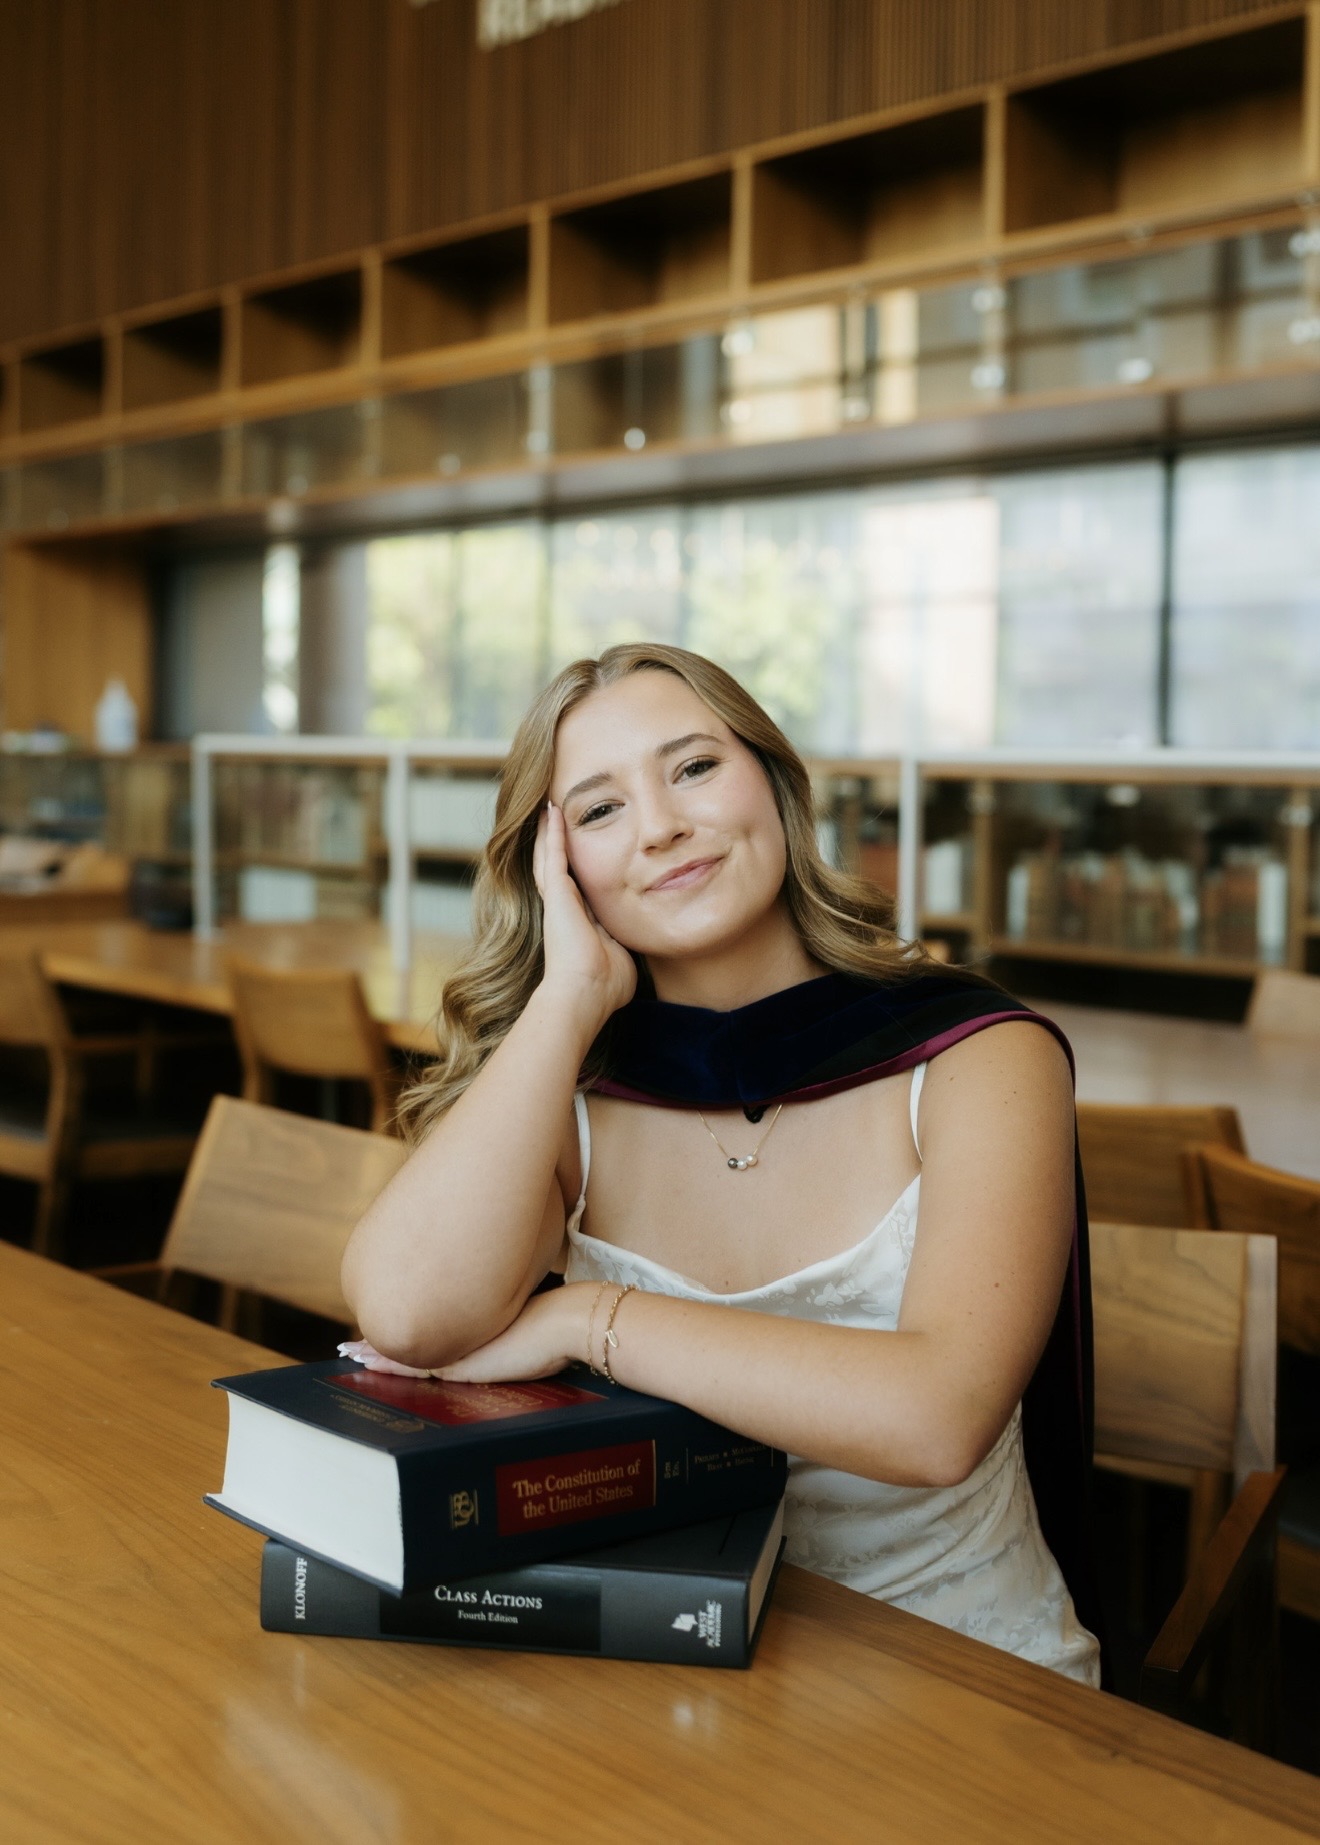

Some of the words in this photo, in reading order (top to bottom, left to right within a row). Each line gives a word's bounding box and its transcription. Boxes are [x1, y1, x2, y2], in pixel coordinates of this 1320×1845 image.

[512, 1479, 543, 1498] The
[545, 1465, 624, 1492] Constitution
[627, 1458, 641, 1476] of
[523, 1501, 546, 1519] the
[549, 1489, 592, 1513] United
[595, 1485, 633, 1504] States
[295, 1557, 308, 1620] KLONOFF
[434, 1584, 478, 1604] CLASS
[481, 1589, 543, 1610] ACTIONS
[457, 1609, 487, 1622] Fourth
[487, 1611, 518, 1624] Edition
